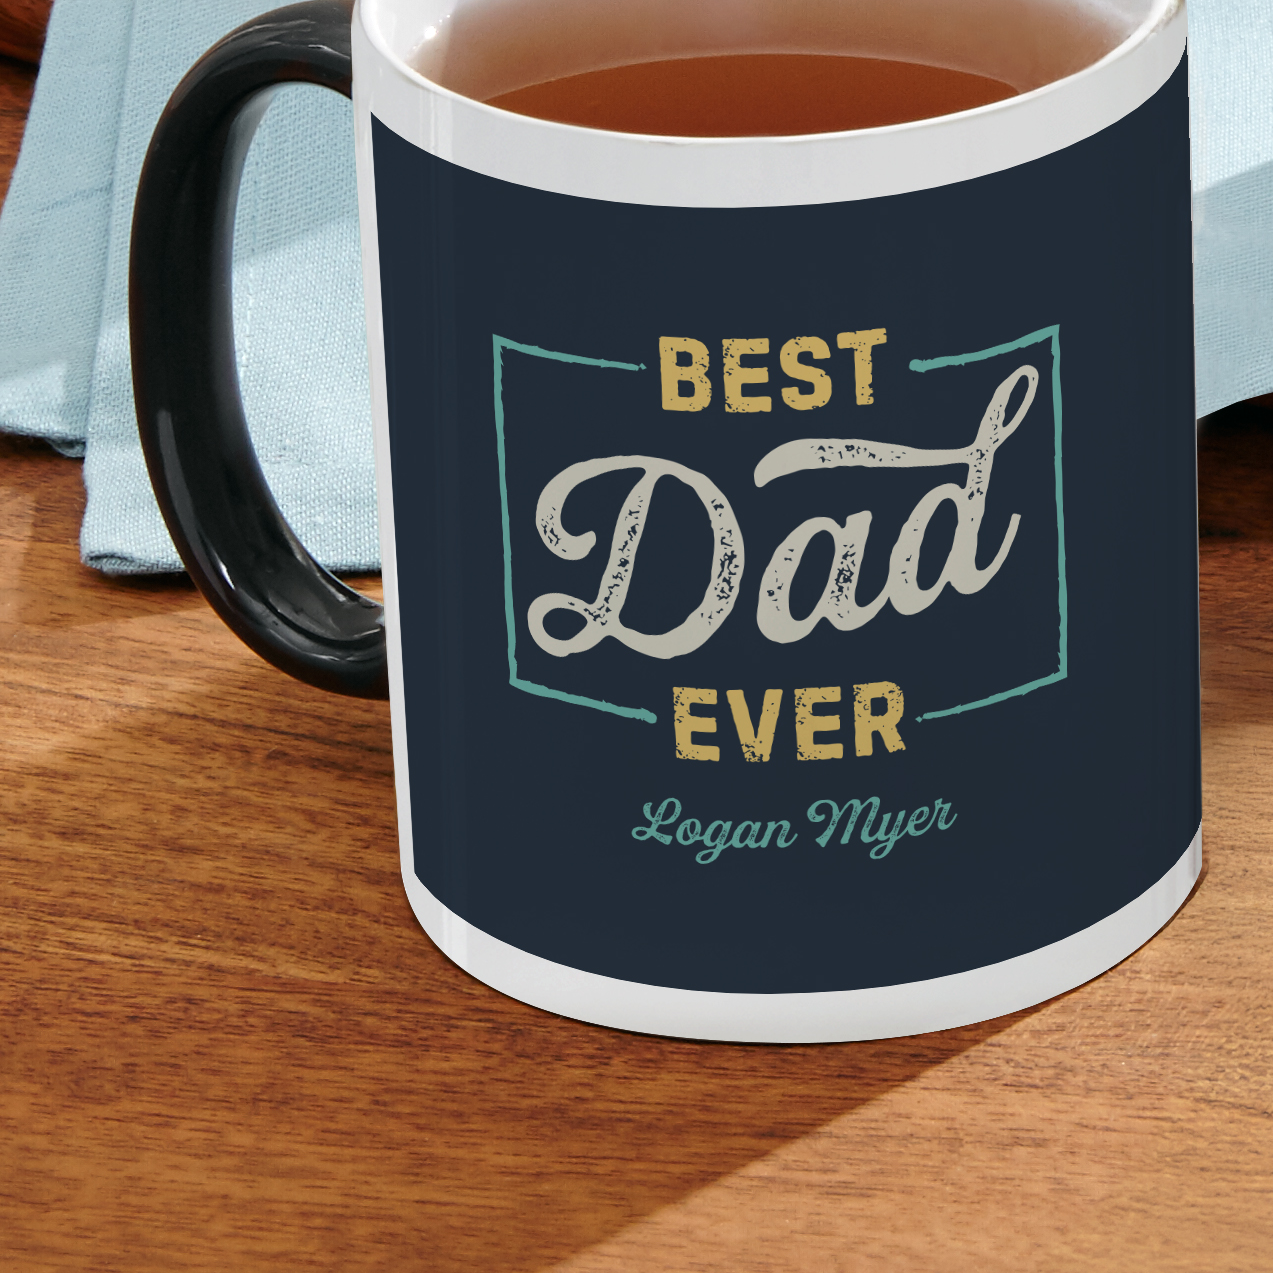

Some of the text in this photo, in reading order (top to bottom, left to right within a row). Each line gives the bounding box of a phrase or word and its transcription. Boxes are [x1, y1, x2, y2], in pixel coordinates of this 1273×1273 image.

[658, 327, 888, 414] BEST
[526, 364, 1040, 660] Dad
[672, 680, 907, 763] EVER
[631, 796, 959, 865] Logan Myer
